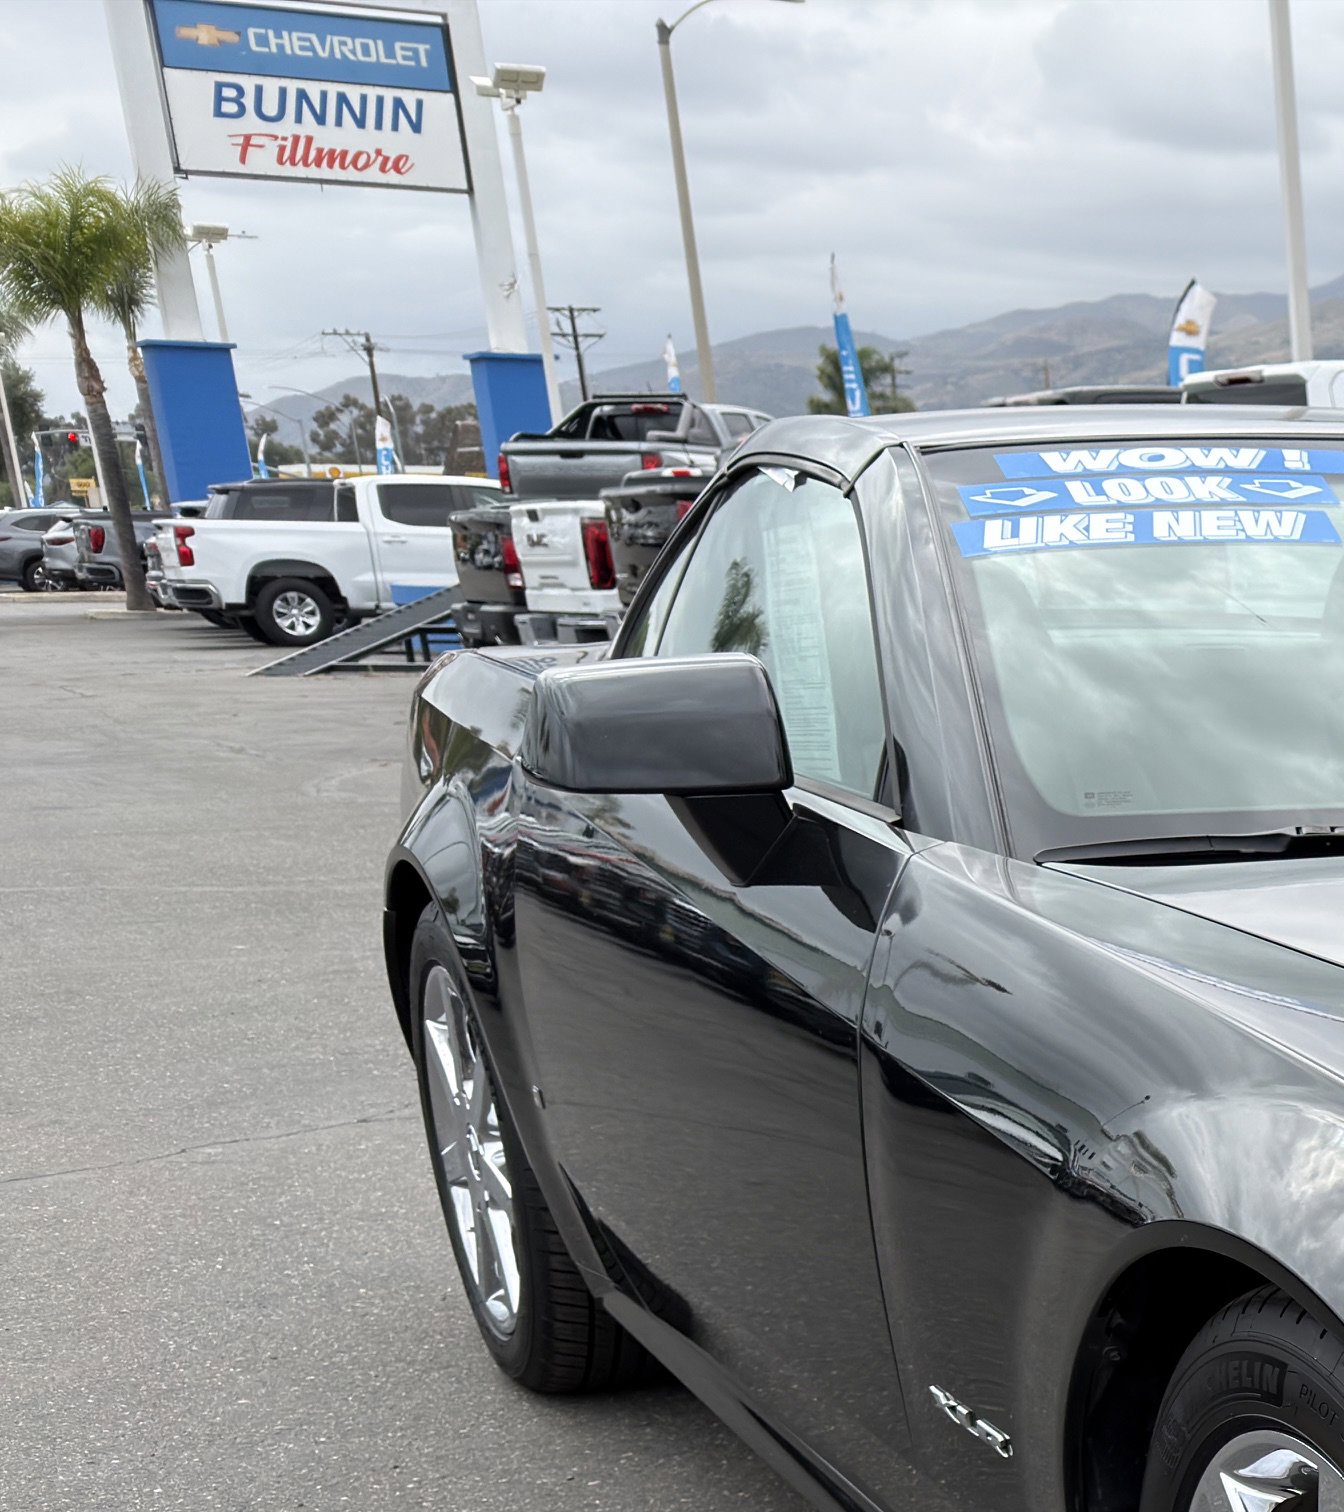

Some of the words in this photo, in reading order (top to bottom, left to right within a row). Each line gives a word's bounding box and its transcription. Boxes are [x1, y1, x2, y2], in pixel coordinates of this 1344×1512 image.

[247, 27, 431, 68] CHEVROLET
[213, 81, 424, 134] BUNNIN
[227, 133, 415, 175] Fillmore
[1065, 476, 1247, 506] LOOK
[983, 512, 1135, 551] LIKE
[1152, 510, 1306, 541] NEW
[1299, 1383, 1340, 1426] PILOT
